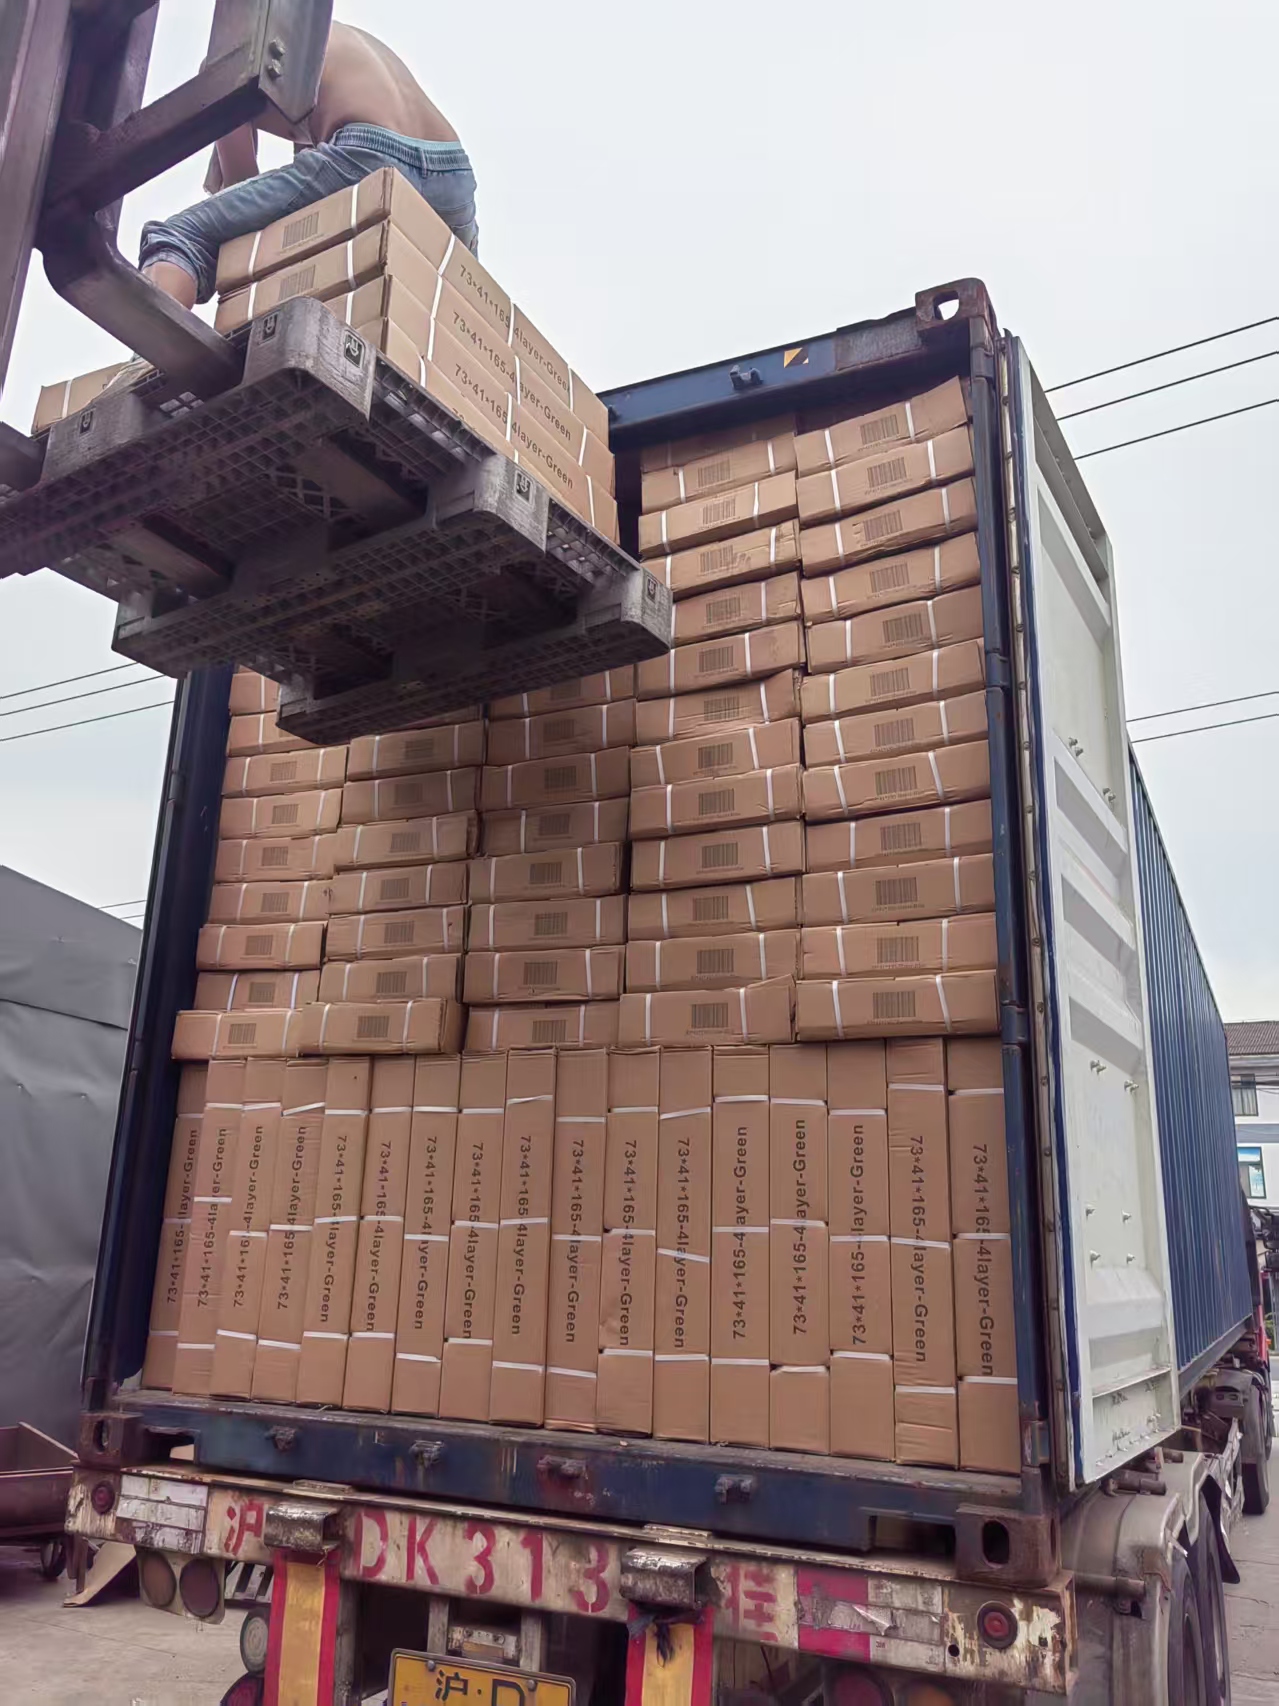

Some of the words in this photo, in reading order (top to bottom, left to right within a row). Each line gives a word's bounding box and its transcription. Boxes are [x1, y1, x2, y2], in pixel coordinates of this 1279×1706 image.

[453, 311, 571, 440] 7341165-4ayer-Green
[455, 363, 573, 489] 73411654layer-Green
[277, 1125, 308, 1311] 73411654layer-Green
[511, 1134, 533, 1336] 73411654layer-Green
[732, 1125, 748, 1341] 7341165-4ayer-Green
[792, 1118, 810, 1336] 7341165-4ayer-Green
